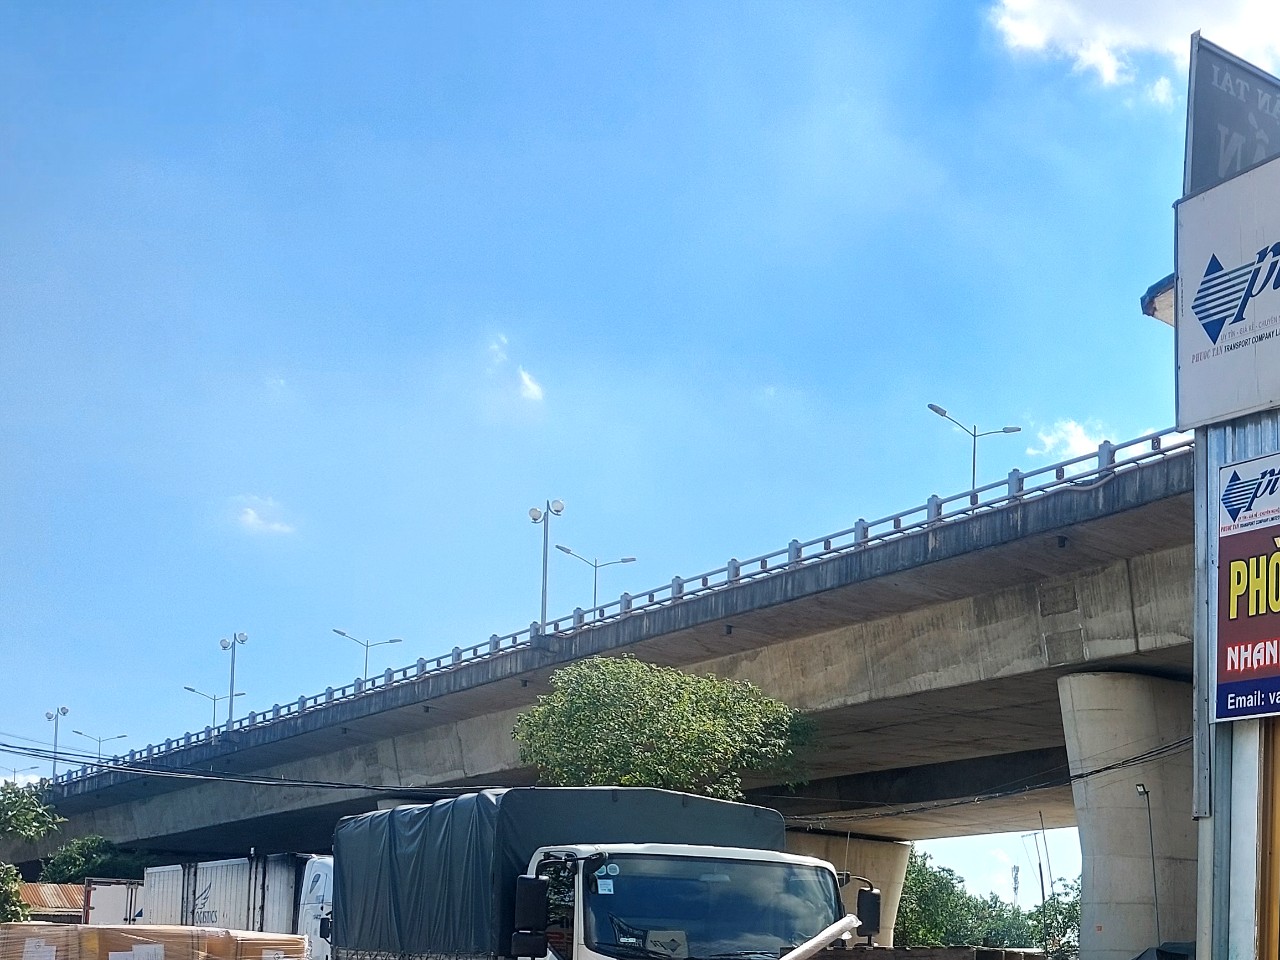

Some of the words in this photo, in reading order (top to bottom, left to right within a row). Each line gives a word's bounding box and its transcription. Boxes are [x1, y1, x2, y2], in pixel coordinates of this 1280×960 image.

[1223, 336, 1251, 352] TRANSPORT
[1251, 331, 1275, 344] COMPANY
[1227, 689, 1265, 711] Email:
